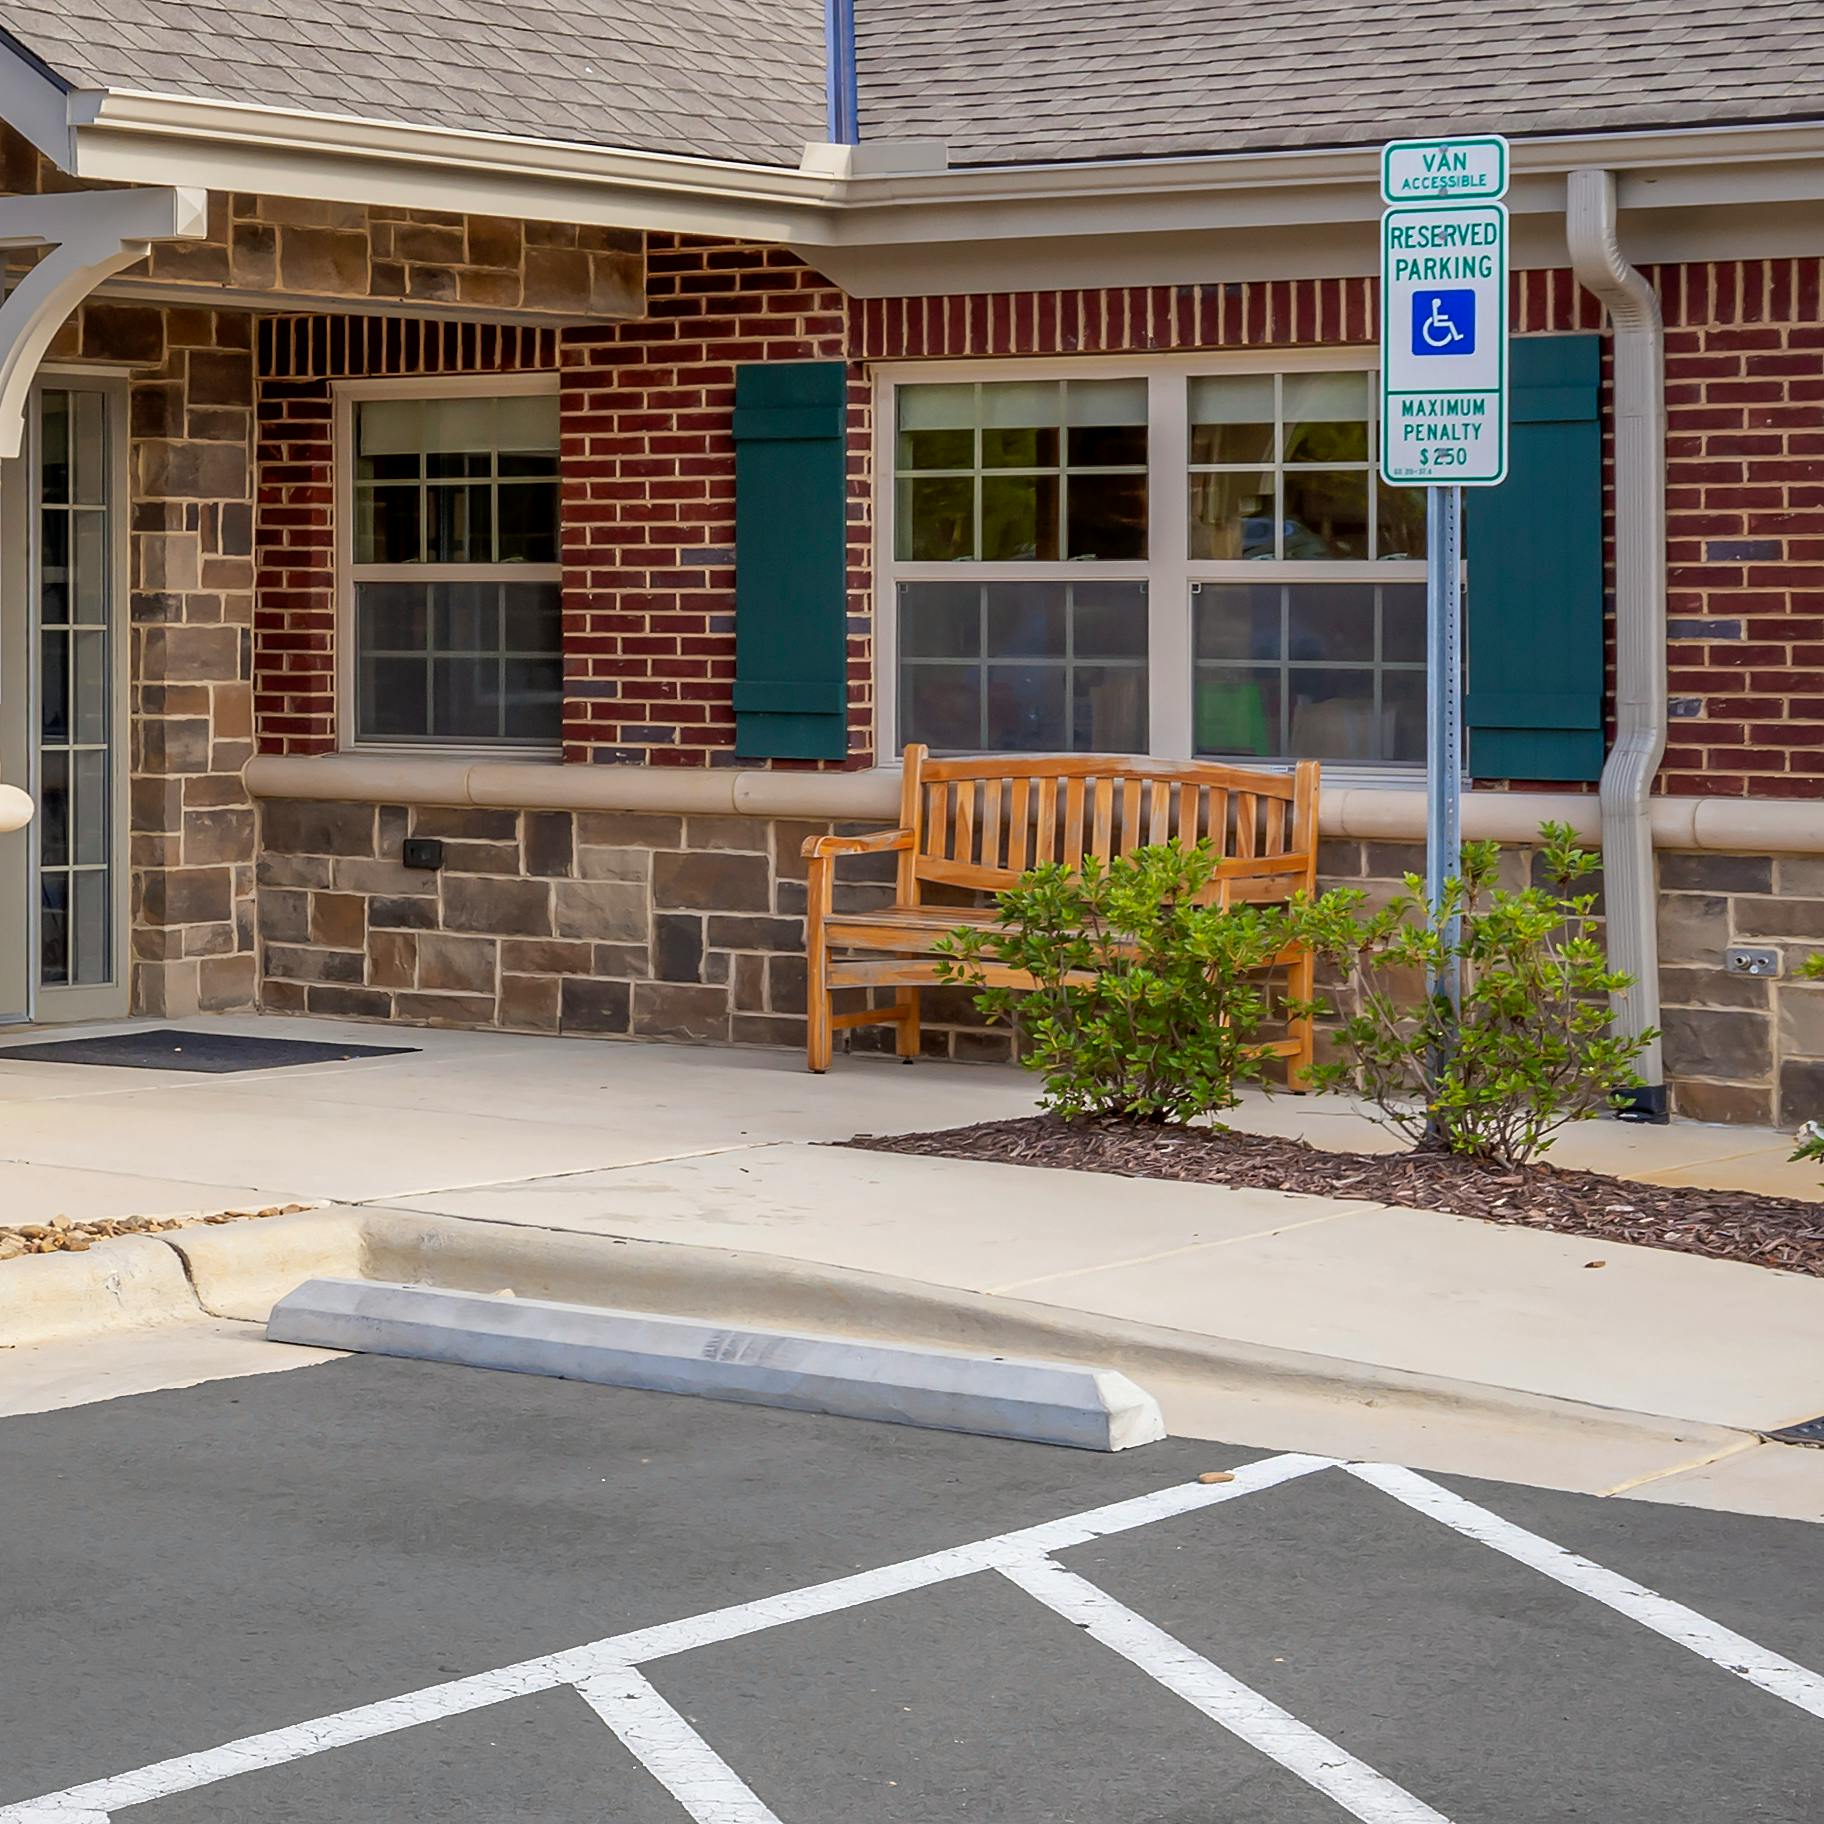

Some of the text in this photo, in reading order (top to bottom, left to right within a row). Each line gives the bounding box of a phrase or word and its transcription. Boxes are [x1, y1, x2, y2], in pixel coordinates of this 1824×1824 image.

[1423, 152, 1467, 173] VAN
[1401, 173, 1487, 191] ACCESSIBLE
[1390, 222, 1497, 249] RESERVED
[1395, 255, 1492, 281] PARKING
[1402, 399, 1485, 417] MAXIMUM
[1403, 423, 1482, 442] PENALTY
